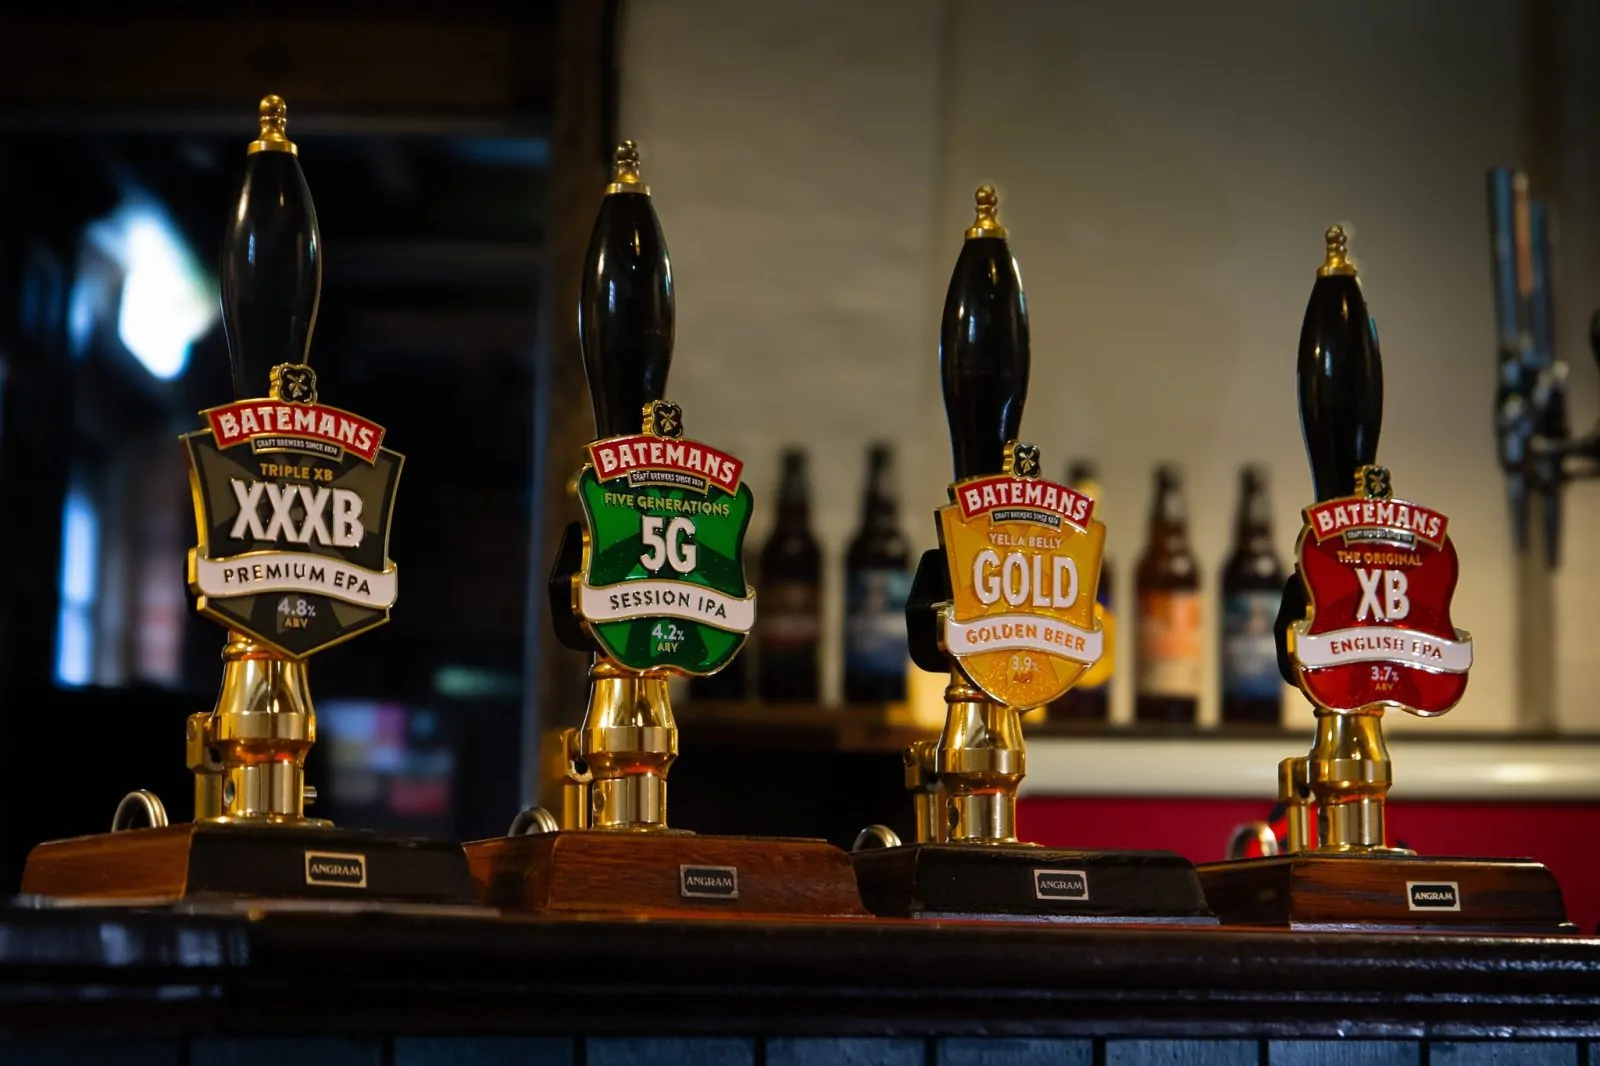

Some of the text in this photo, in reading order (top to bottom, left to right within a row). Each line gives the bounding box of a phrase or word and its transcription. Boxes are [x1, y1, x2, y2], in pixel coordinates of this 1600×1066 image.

[217, 406, 376, 452] BATEMANS
[256, 438, 275, 448] CRAFT
[276, 438, 305, 449] BREWERS
[305, 441, 324, 451] SINCE
[259, 463, 333, 483] TRIPLE XB
[598, 442, 737, 485] BATEMANS
[632, 471, 650, 481] CRAFT
[650, 472, 675, 482] BREWERS
[675, 474, 692, 484] SINCE
[603, 491, 731, 518] FIVE GENERATIONS
[963, 478, 1089, 522] BATEMANS
[229, 478, 364, 548] XXXB
[1316, 502, 1441, 539] BATEMANS
[639, 513, 697, 575] 5G
[988, 532, 1063, 550] YELLA BELLY
[1337, 550, 1424, 567] THE ORIGINAL
[223, 563, 372, 596] PREMIUM EPA
[973, 549, 1080, 610] GOLD
[609, 589, 728, 619] SESSION IPA
[1354, 567, 1411, 622] XB
[277, 597, 316, 617] 4.8%
[283, 618, 309, 629] ABV
[651, 623, 685, 641] 4.2%
[656, 641, 679, 652] ABV
[965, 622, 1087, 653] GOLDEN BEER
[1330, 636, 1443, 660] ENGLISH EPA
[1374, 682, 1395, 692] ABV
[310, 863, 360, 877] ANGRAM
[686, 876, 733, 888] ANGRAM
[1039, 880, 1083, 890] ANGRAM
[1414, 891, 1453, 900] ANGRAM
